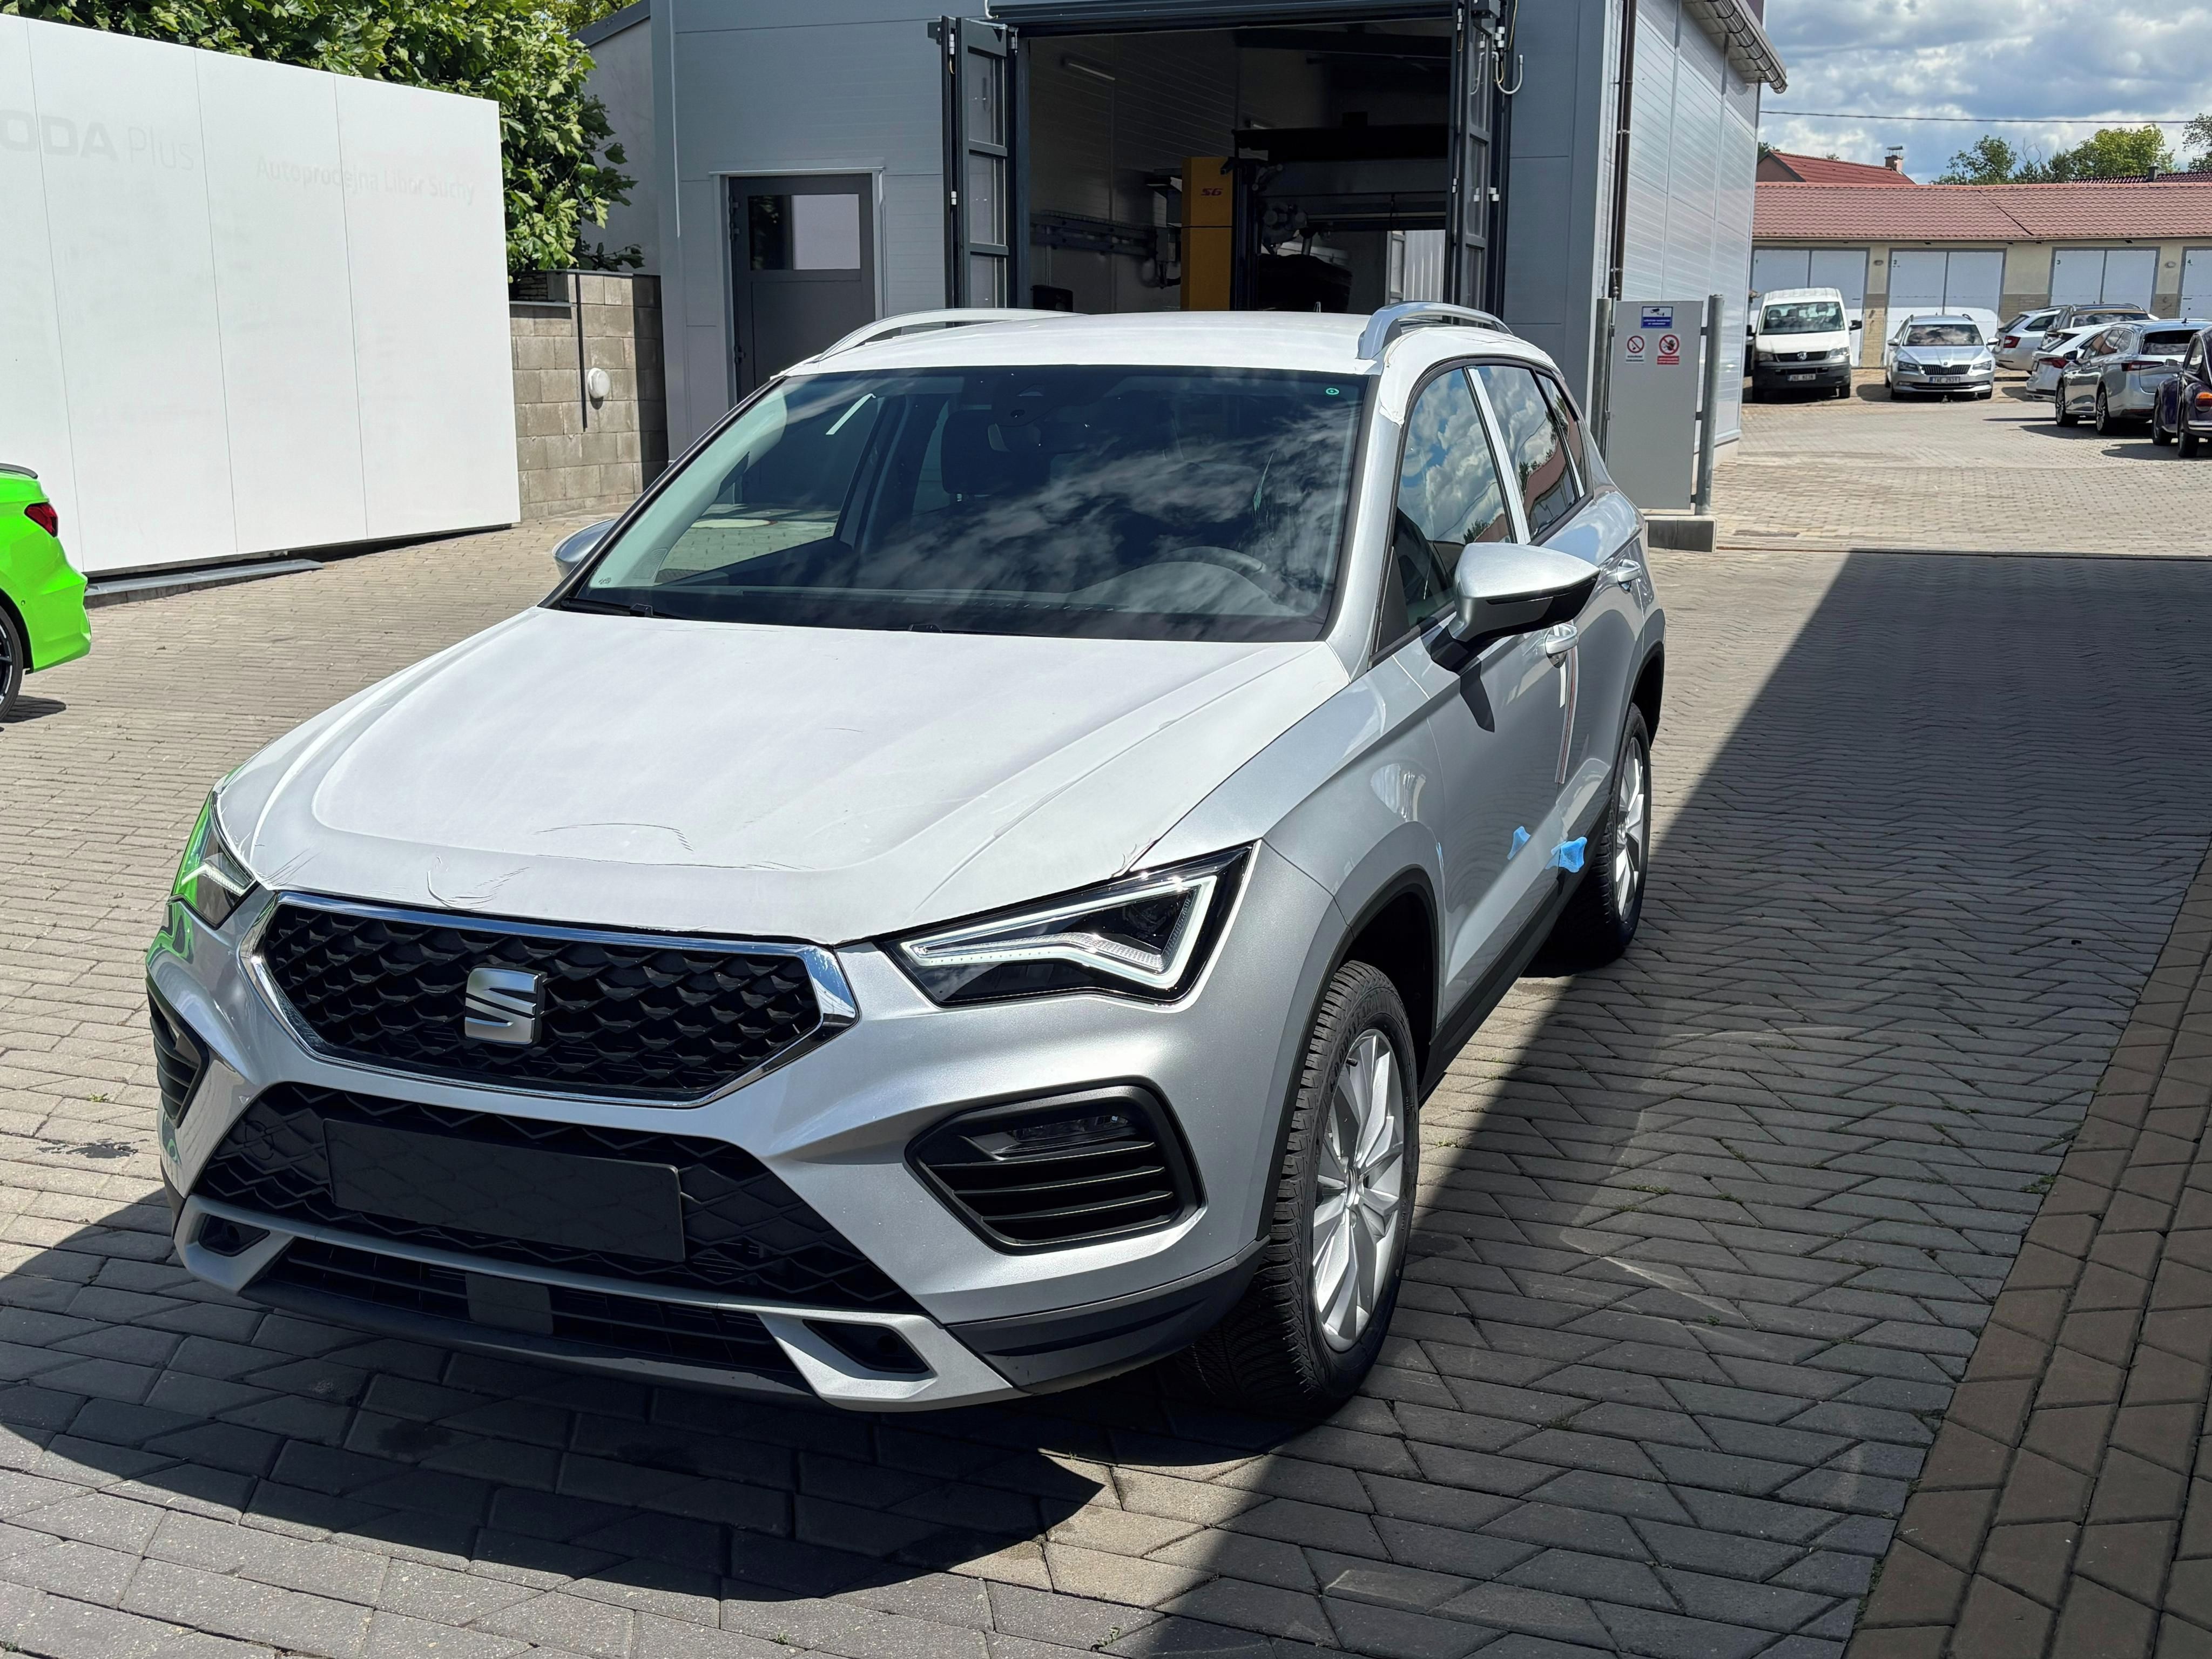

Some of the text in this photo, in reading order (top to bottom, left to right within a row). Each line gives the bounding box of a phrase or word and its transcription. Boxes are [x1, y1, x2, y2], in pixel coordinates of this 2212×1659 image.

[128, 122, 194, 171] Plus
[257, 155, 379, 195] Autoprodejna
[384, 169, 424, 195] Libor
